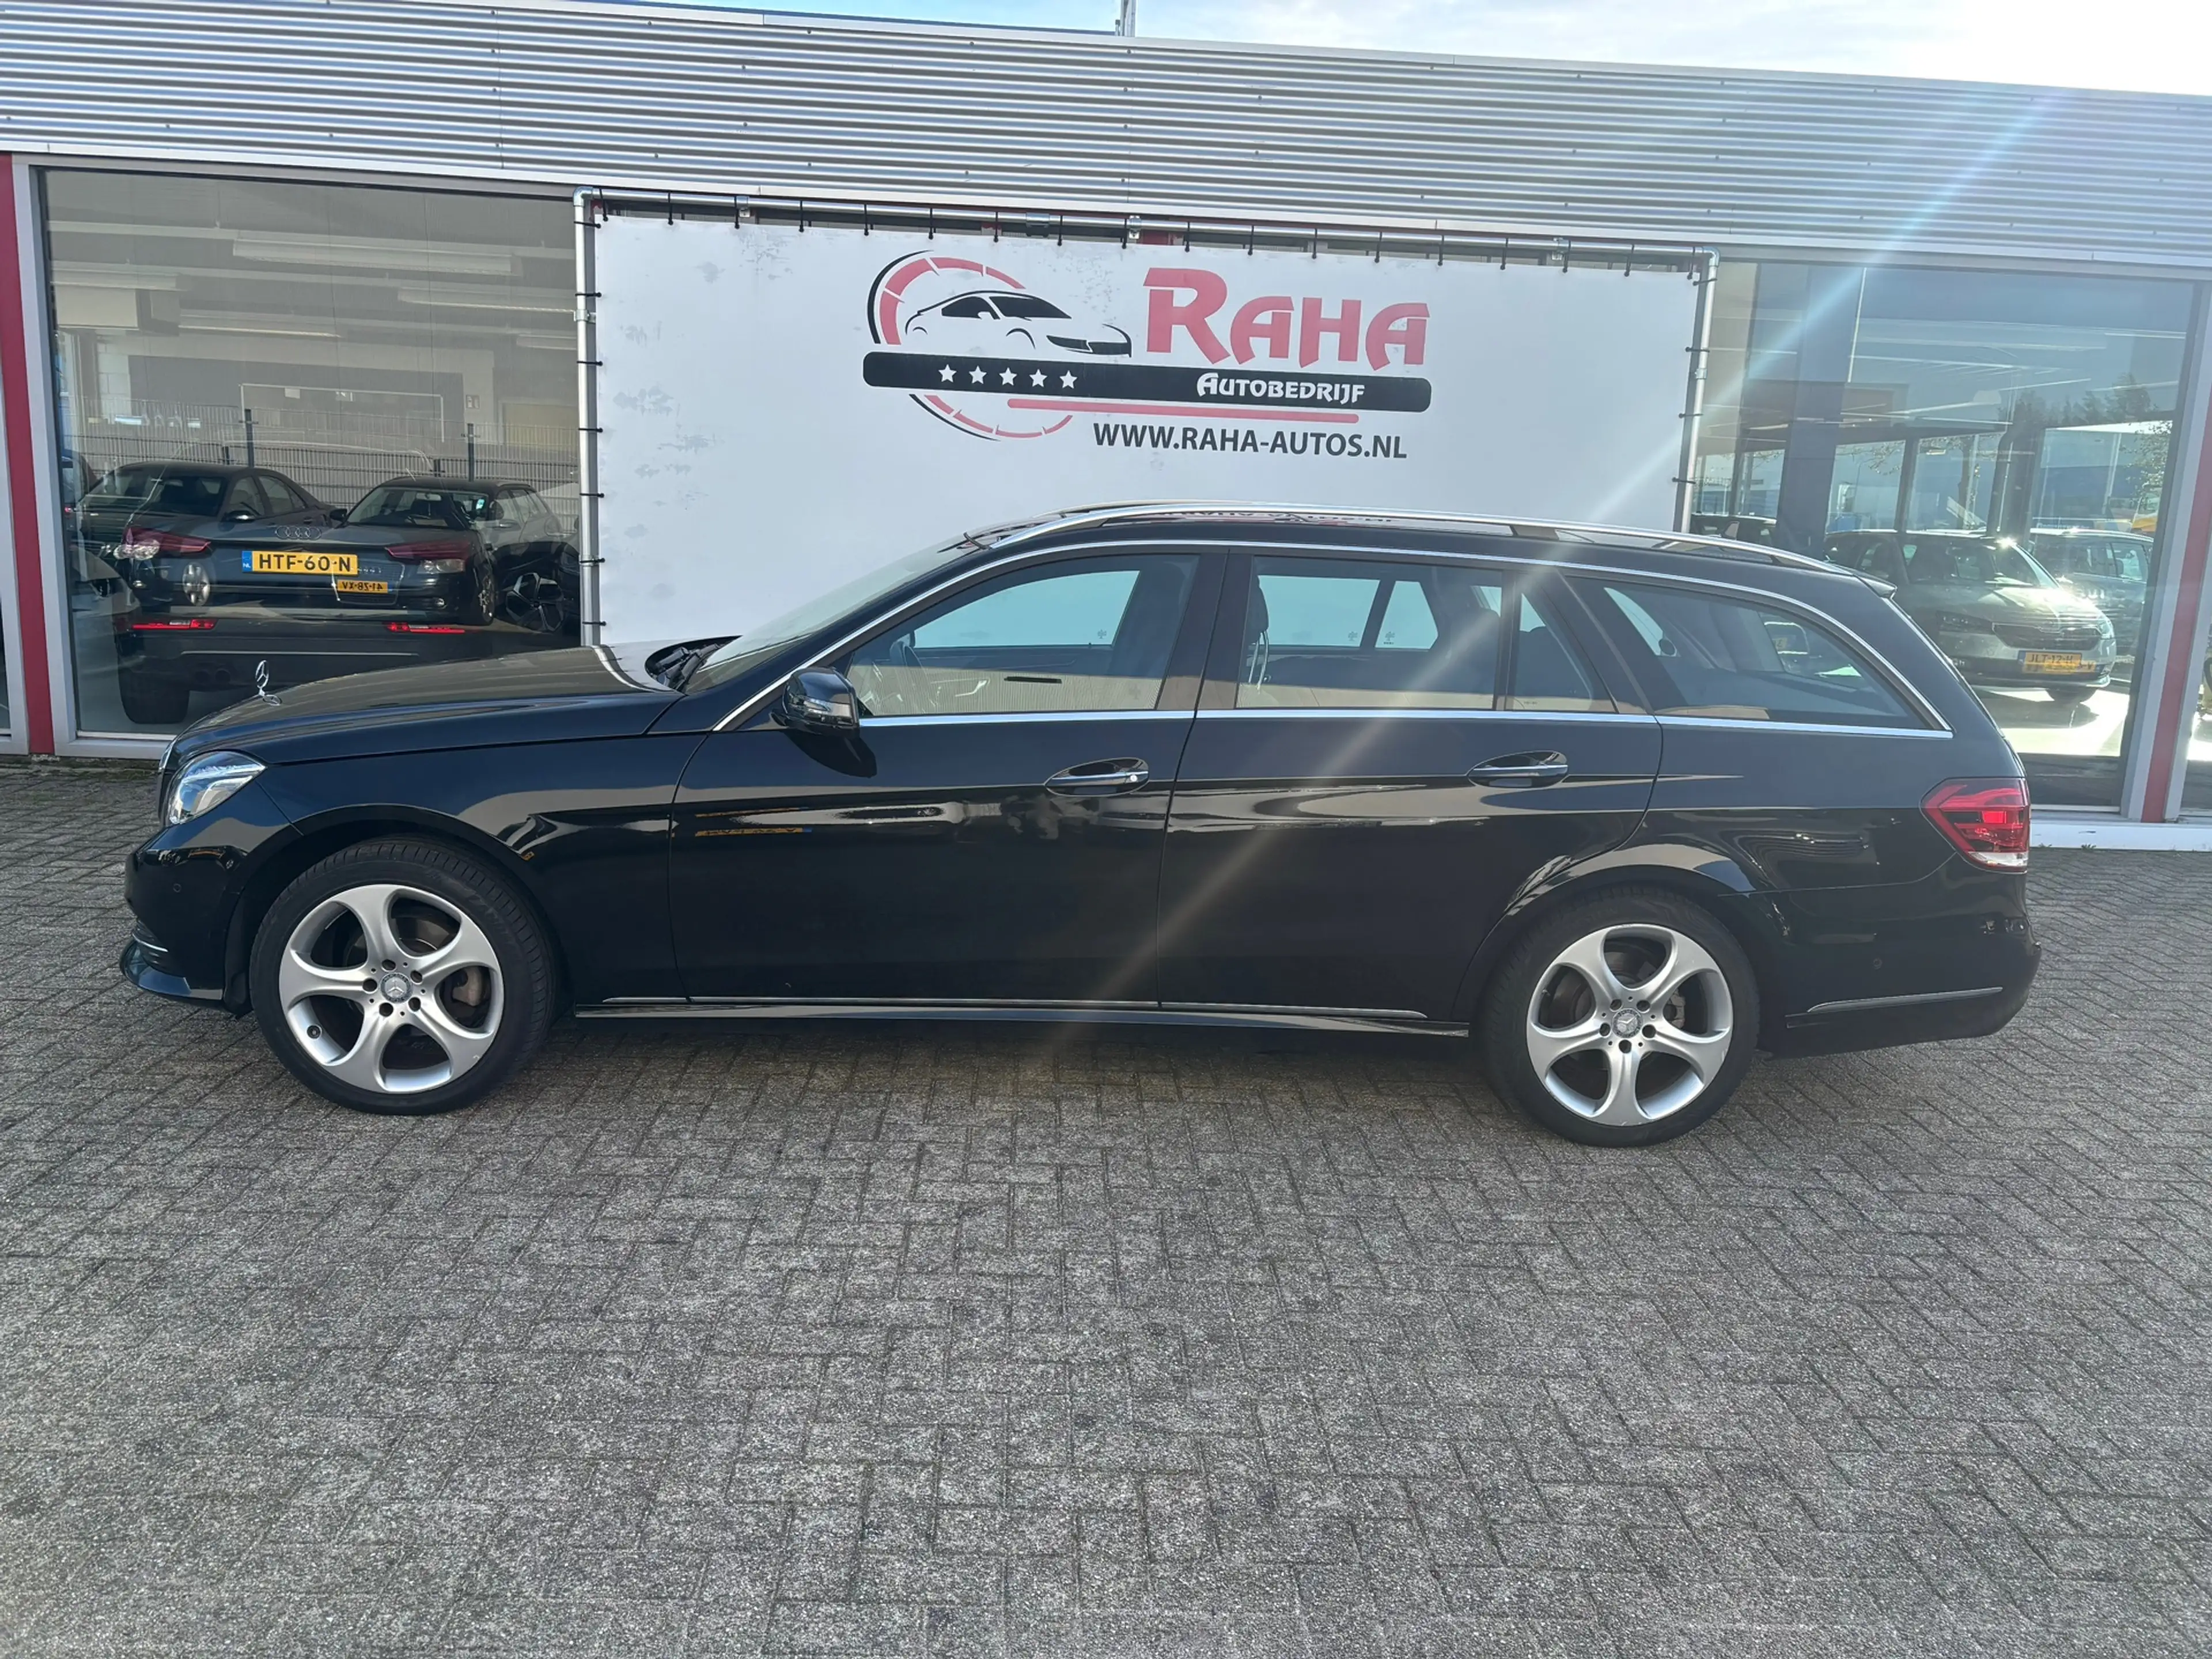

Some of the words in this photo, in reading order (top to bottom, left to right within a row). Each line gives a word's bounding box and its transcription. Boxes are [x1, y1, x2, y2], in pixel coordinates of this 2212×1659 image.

[1143, 267, 1430, 370] RAHA
[1196, 373, 1365, 404] AUTOBEDRIJF
[1093, 422, 1407, 459] WWW.RAHA-AUTOS.NL
[259, 554, 351, 572] HTF-60-N
